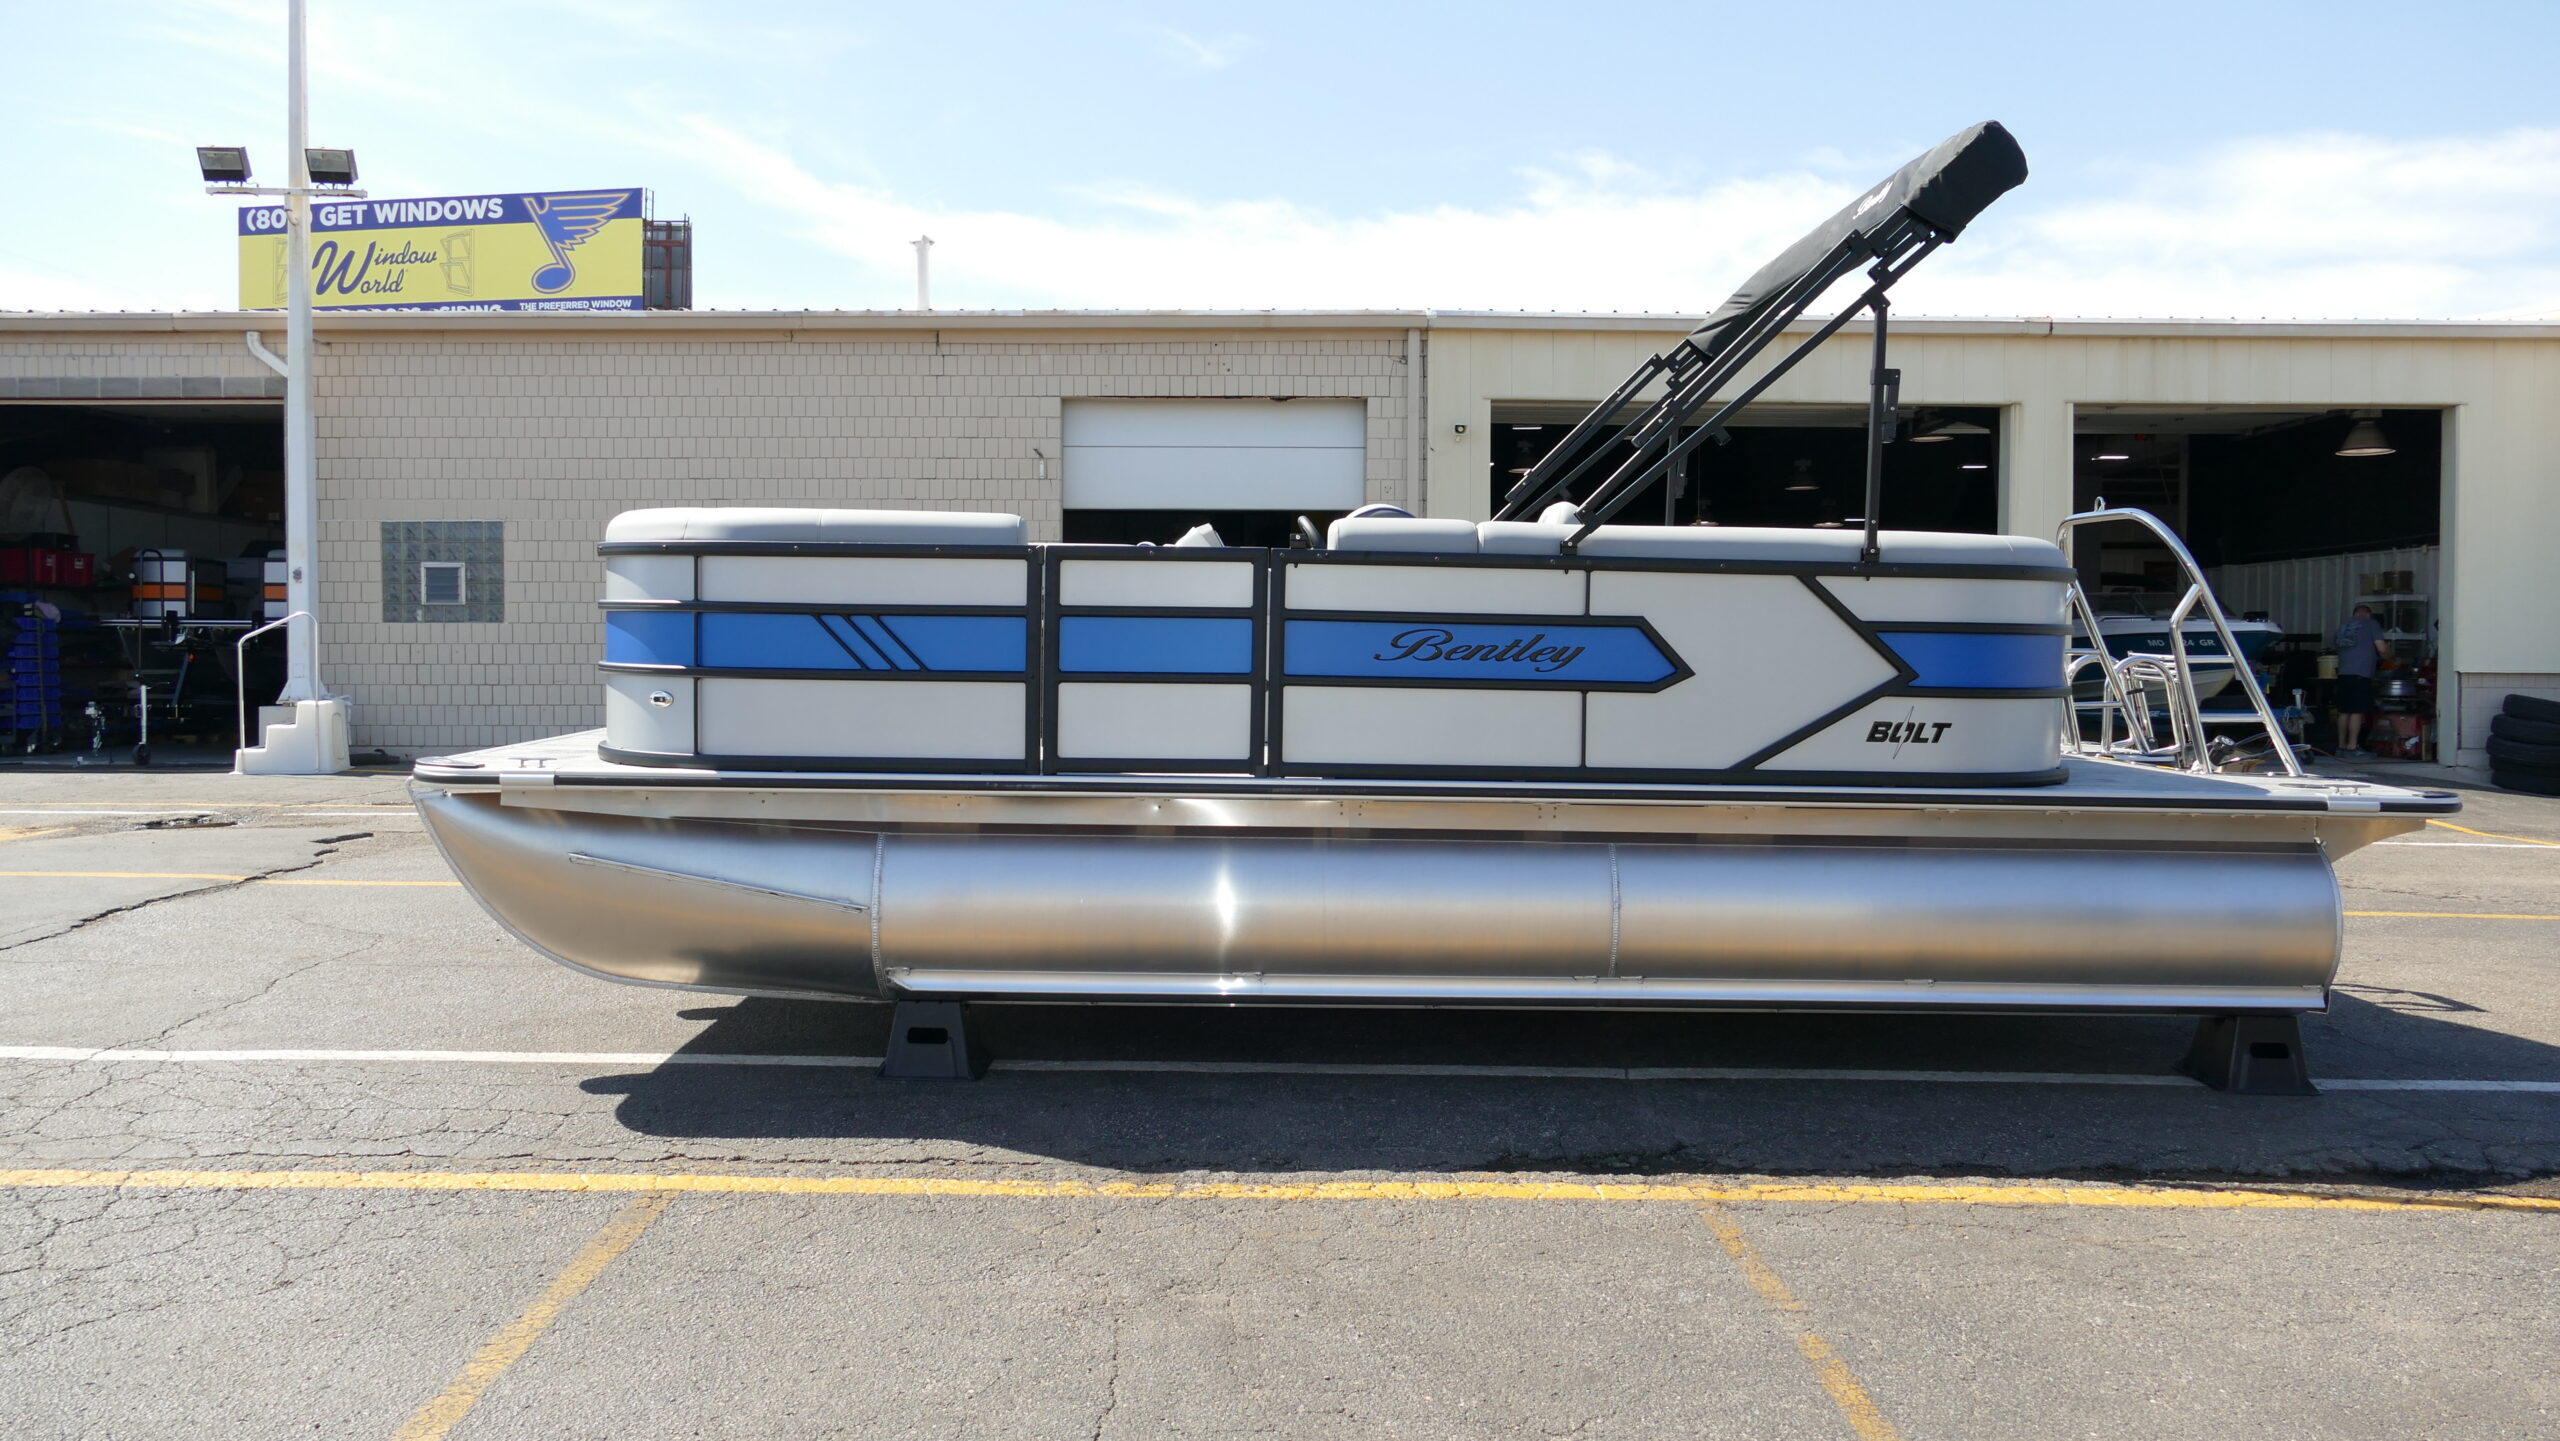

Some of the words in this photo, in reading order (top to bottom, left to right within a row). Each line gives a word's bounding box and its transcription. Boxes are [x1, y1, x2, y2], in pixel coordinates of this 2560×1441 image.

[246, 209, 313, 231] (80
[319, 205, 367, 226] GET
[374, 199, 503, 223] WINDOWS
[520, 302, 537, 311] THE
[539, 300, 589, 310] PREFERRED
[591, 299, 632, 309] WINDOW
[1373, 628, 1586, 672] Bentley
[2147, 639, 2165, 647] MO
[2199, 639, 2216, 647] GR
[1866, 721, 1952, 743] BOLT
